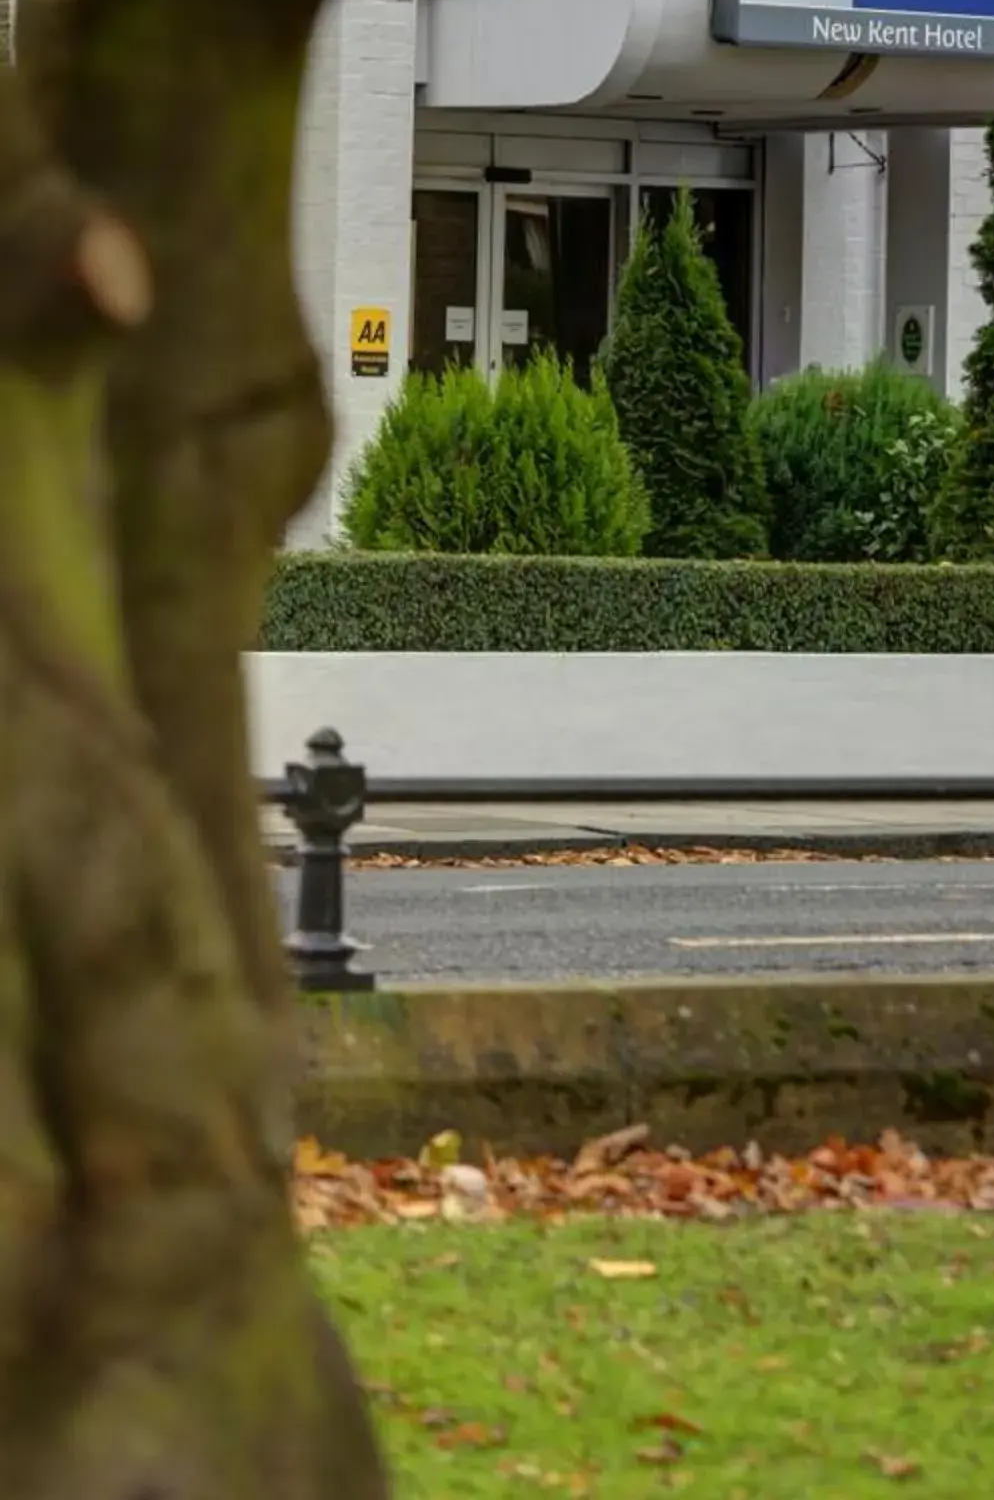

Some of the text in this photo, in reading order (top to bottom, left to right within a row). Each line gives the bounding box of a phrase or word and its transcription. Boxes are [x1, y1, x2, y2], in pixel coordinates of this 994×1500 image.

[812, 16, 982, 49] New Kent Hotel
[358, 320, 386, 344] AA
